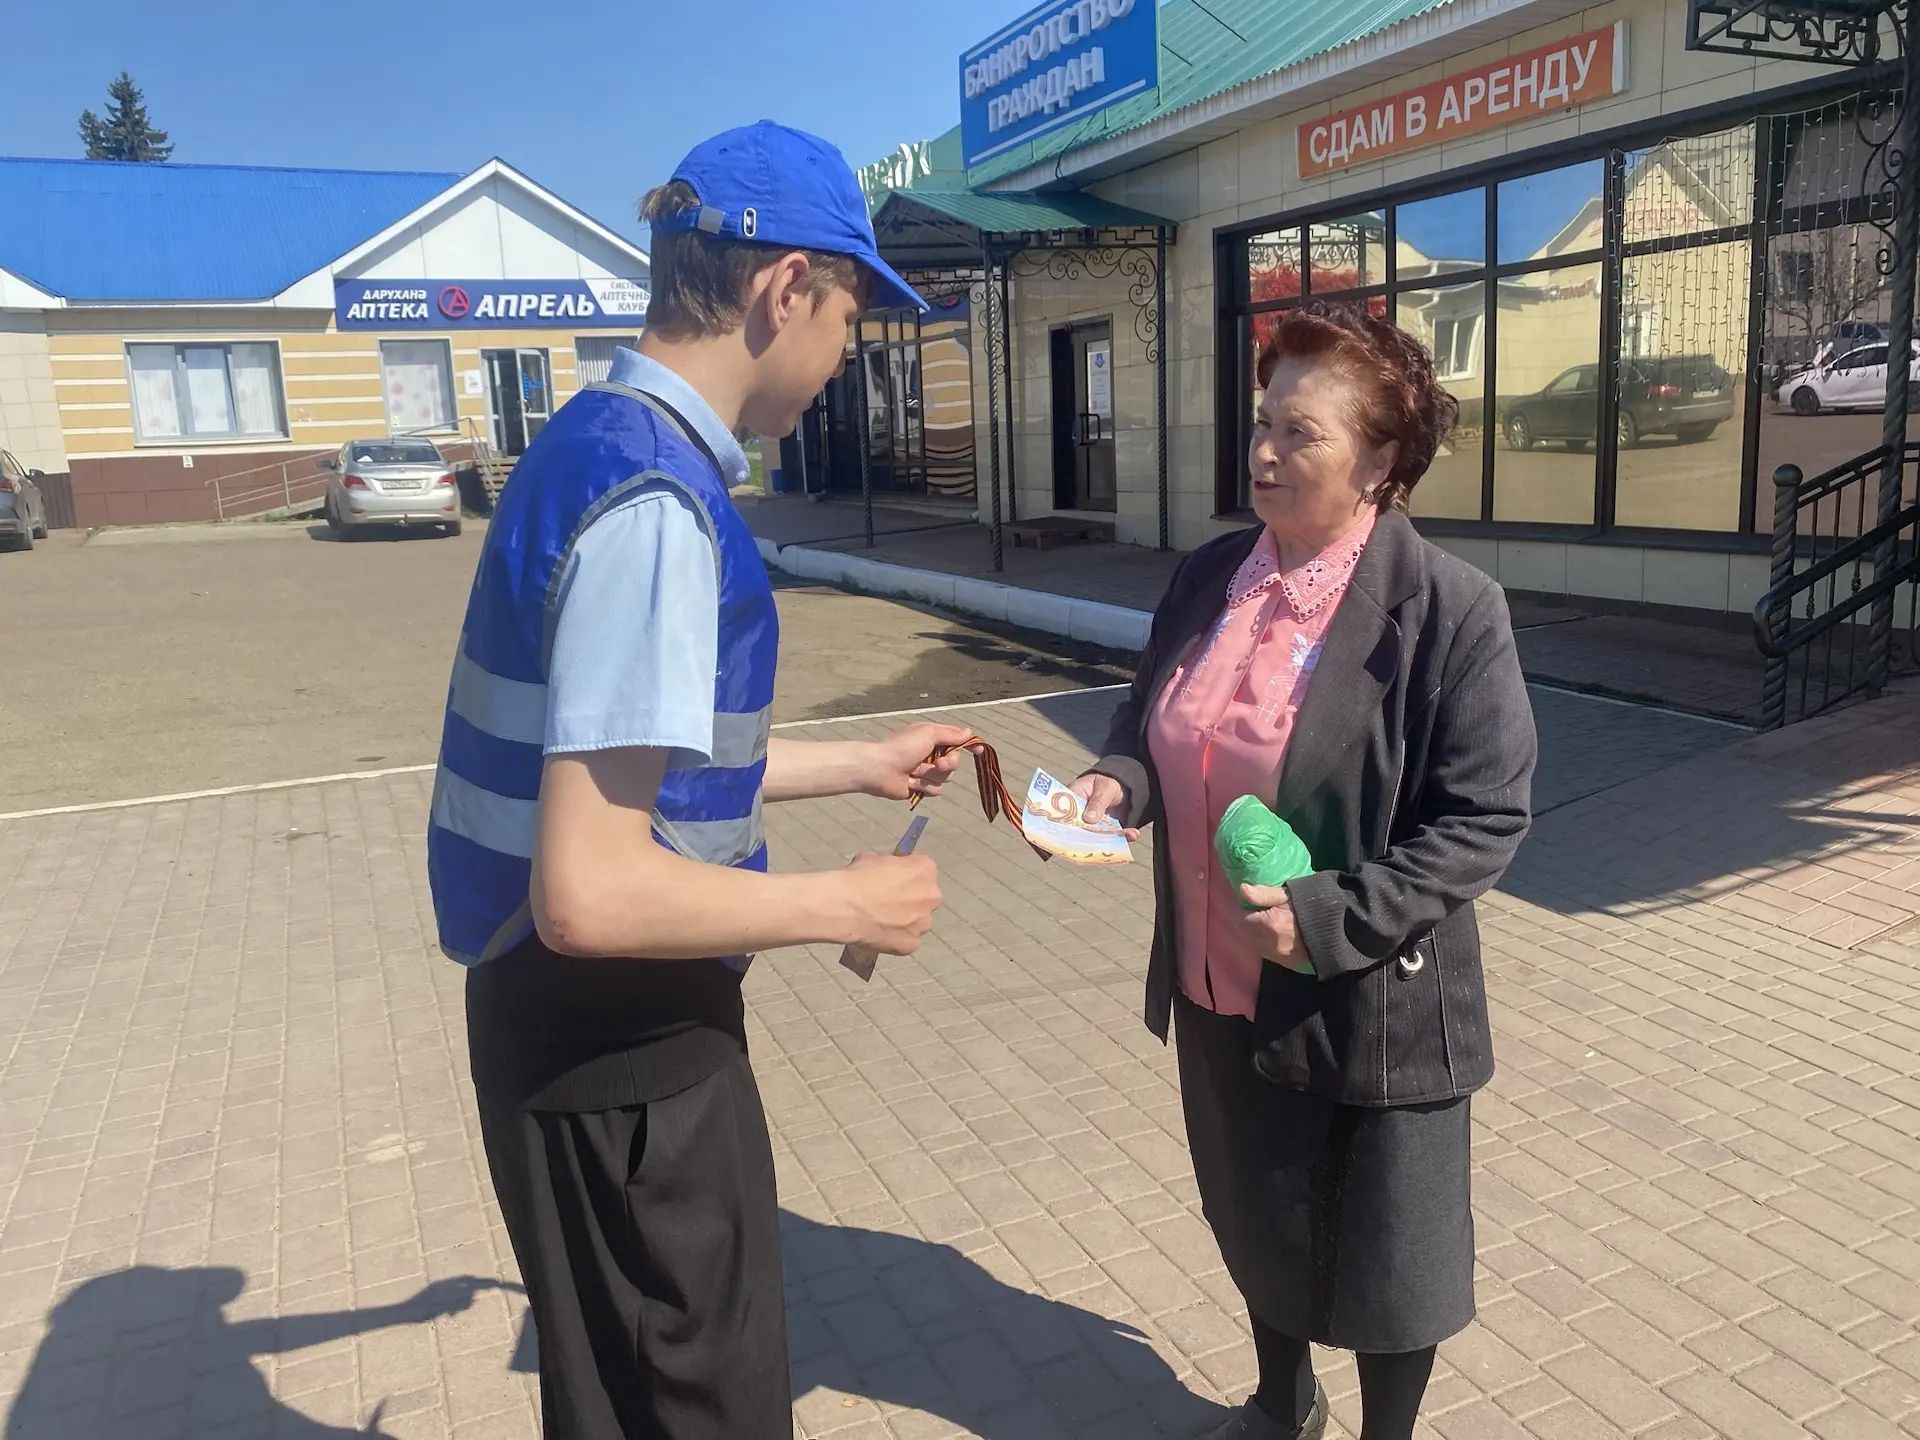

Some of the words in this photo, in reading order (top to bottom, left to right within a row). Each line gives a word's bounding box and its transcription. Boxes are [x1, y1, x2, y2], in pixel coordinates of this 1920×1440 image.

[988, 47, 1105, 132] ГРАЖДАН
[1309, 104, 1394, 168] СДАМ
[1405, 96, 1427, 138] В
[1437, 39, 1598, 129] АРЕНДУ
[346, 303, 429, 319] АПТЕКА
[474, 294, 595, 318] АПРЕЛЬ
[618, 302, 645, 312] КЛУБ
